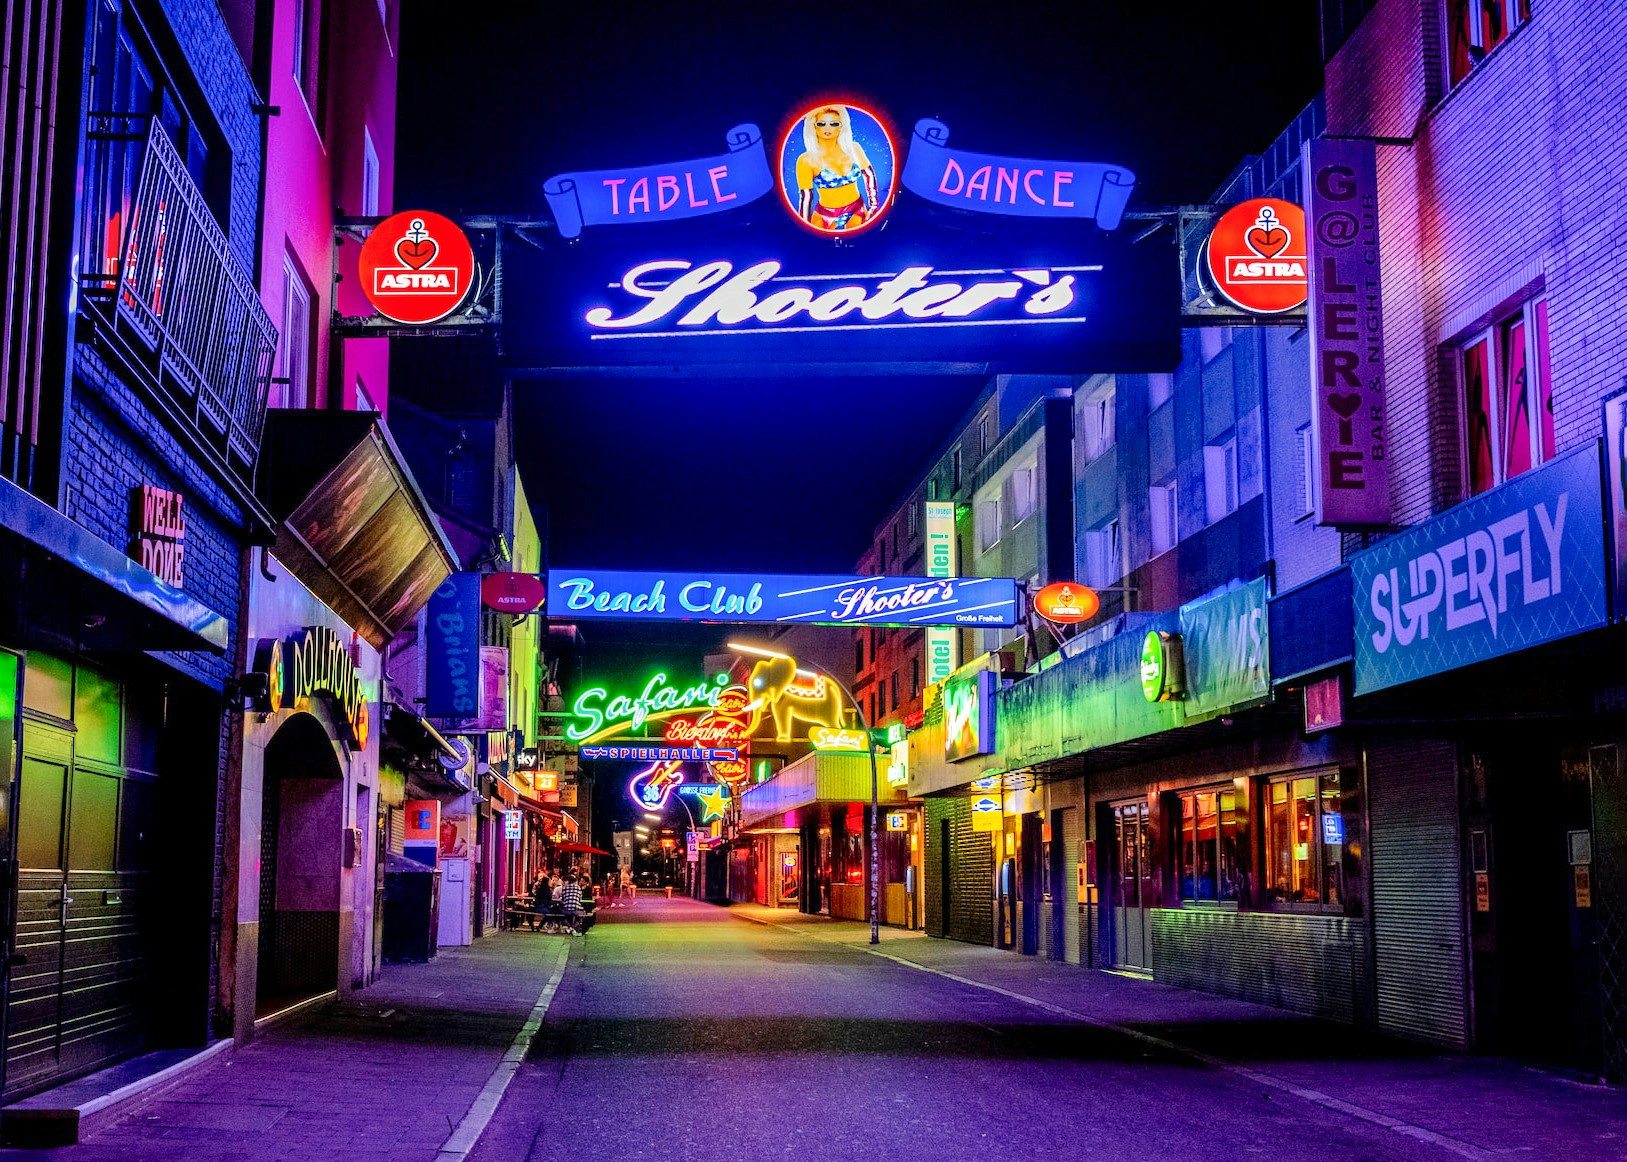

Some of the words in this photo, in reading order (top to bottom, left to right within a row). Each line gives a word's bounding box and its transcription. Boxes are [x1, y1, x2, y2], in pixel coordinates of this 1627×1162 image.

[602, 165, 737, 216] TABLE
[939, 158, 1075, 208] DANCE
[1362, 193, 1377, 266] CLUB
[381, 274, 450, 288] ASTRA
[1233, 262, 1305, 277] ASTRA
[1366, 279, 1381, 364] NIGHT
[1370, 404, 1385, 462] BAR
[143, 484, 185, 540] WELL
[1370, 491, 1569, 654] SUPERFLY
[497, 596, 527, 604] ASTRA
[558, 577, 666, 614] Beach
[678, 580, 763, 615] Club
[956, 614, 977, 623] Große
[978, 614, 1003, 623] Freiheit
[609, 748, 711, 760] SPIELHALLE
[643, 785, 660, 802] 36
